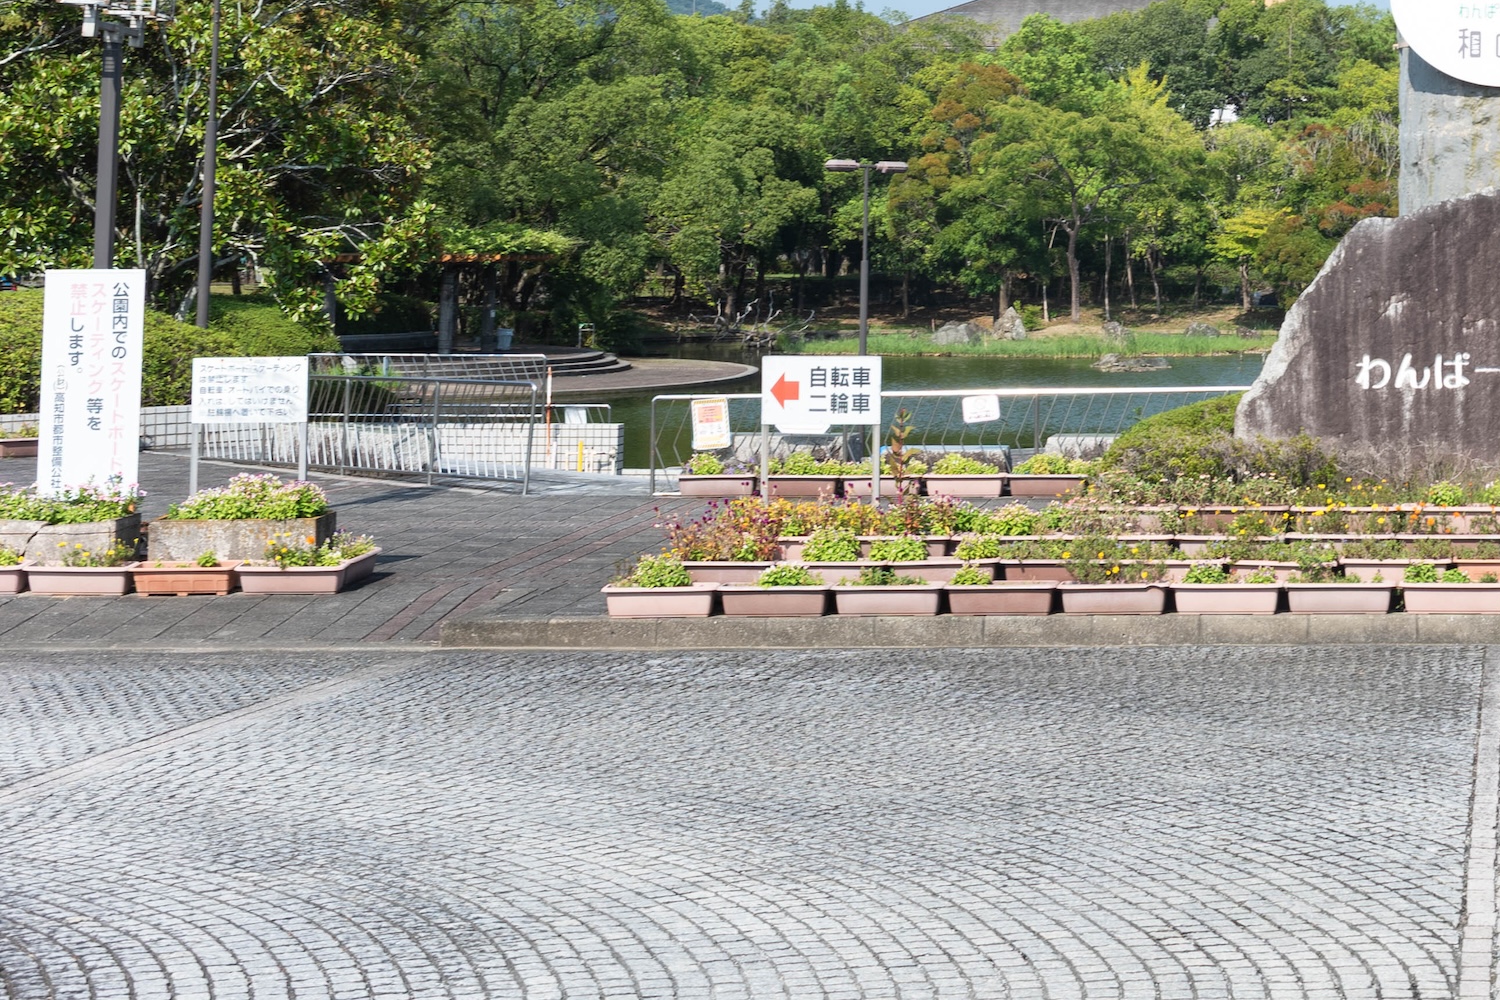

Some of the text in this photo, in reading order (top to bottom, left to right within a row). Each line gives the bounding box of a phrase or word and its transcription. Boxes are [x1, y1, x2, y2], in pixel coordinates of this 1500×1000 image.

[68, 283, 88, 374] 禁止します。
[810, 365, 871, 389] 自転車
[808, 392, 871, 415] 二輪車
